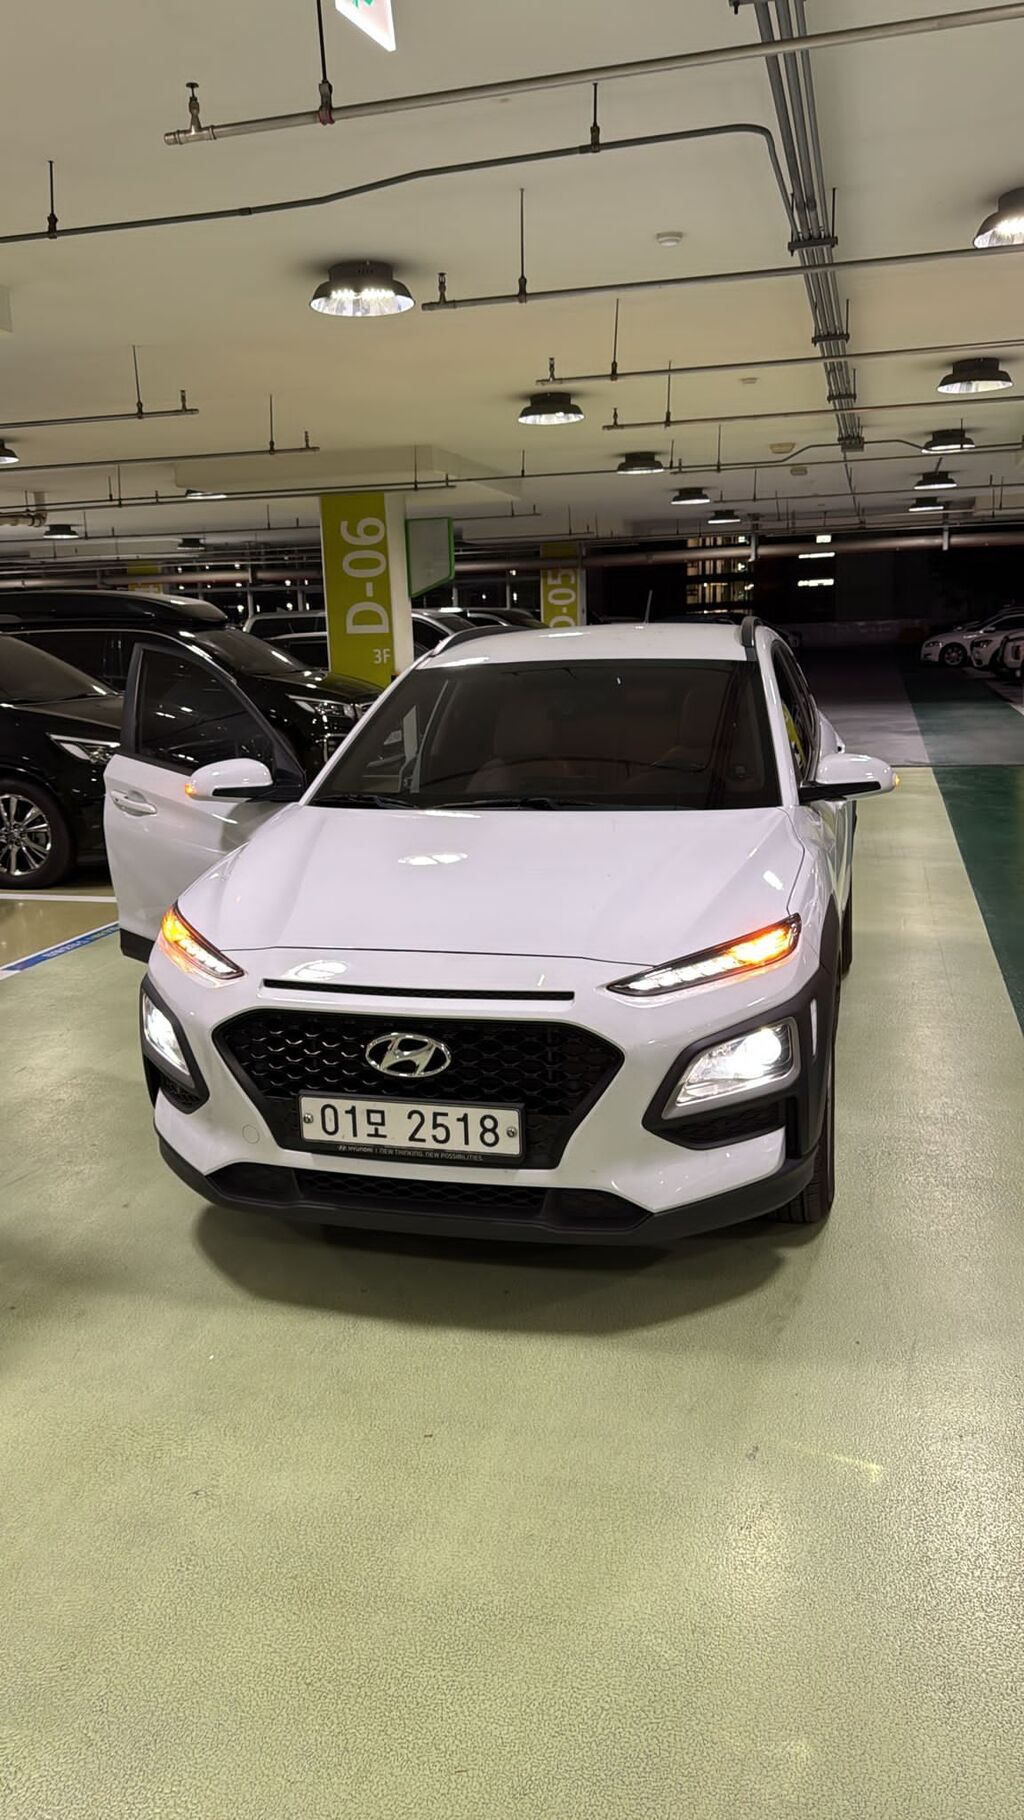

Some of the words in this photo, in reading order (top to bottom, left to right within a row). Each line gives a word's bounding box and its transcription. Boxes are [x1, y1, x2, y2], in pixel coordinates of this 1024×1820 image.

[340, 517, 391, 635] D-06
[372, 648, 391, 664] 3F
[320, 1103, 387, 1138] 01모
[407, 1109, 500, 1147] 2518
